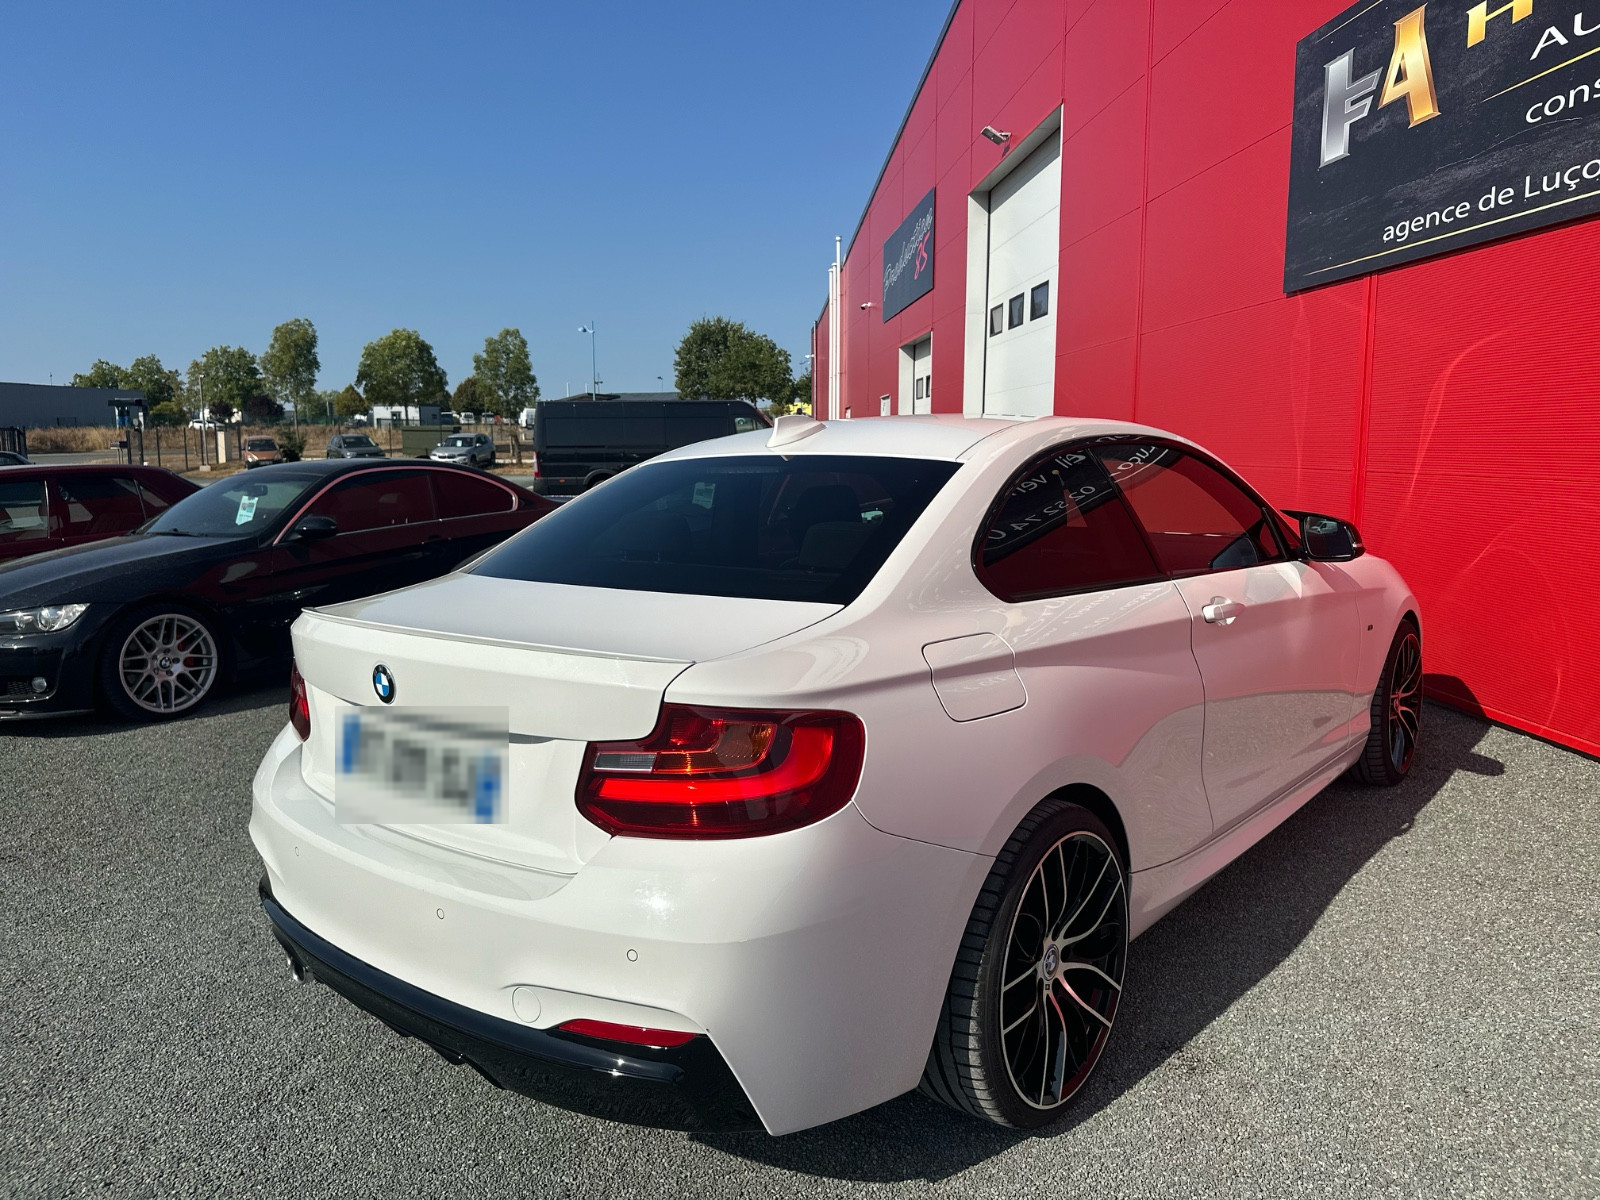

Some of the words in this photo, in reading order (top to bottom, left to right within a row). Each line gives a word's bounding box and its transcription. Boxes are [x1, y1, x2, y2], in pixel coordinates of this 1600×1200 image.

[1382, 201, 1471, 243] agence
[1478, 185, 1515, 212] de
[1524, 158, 1600, 199] Luço
